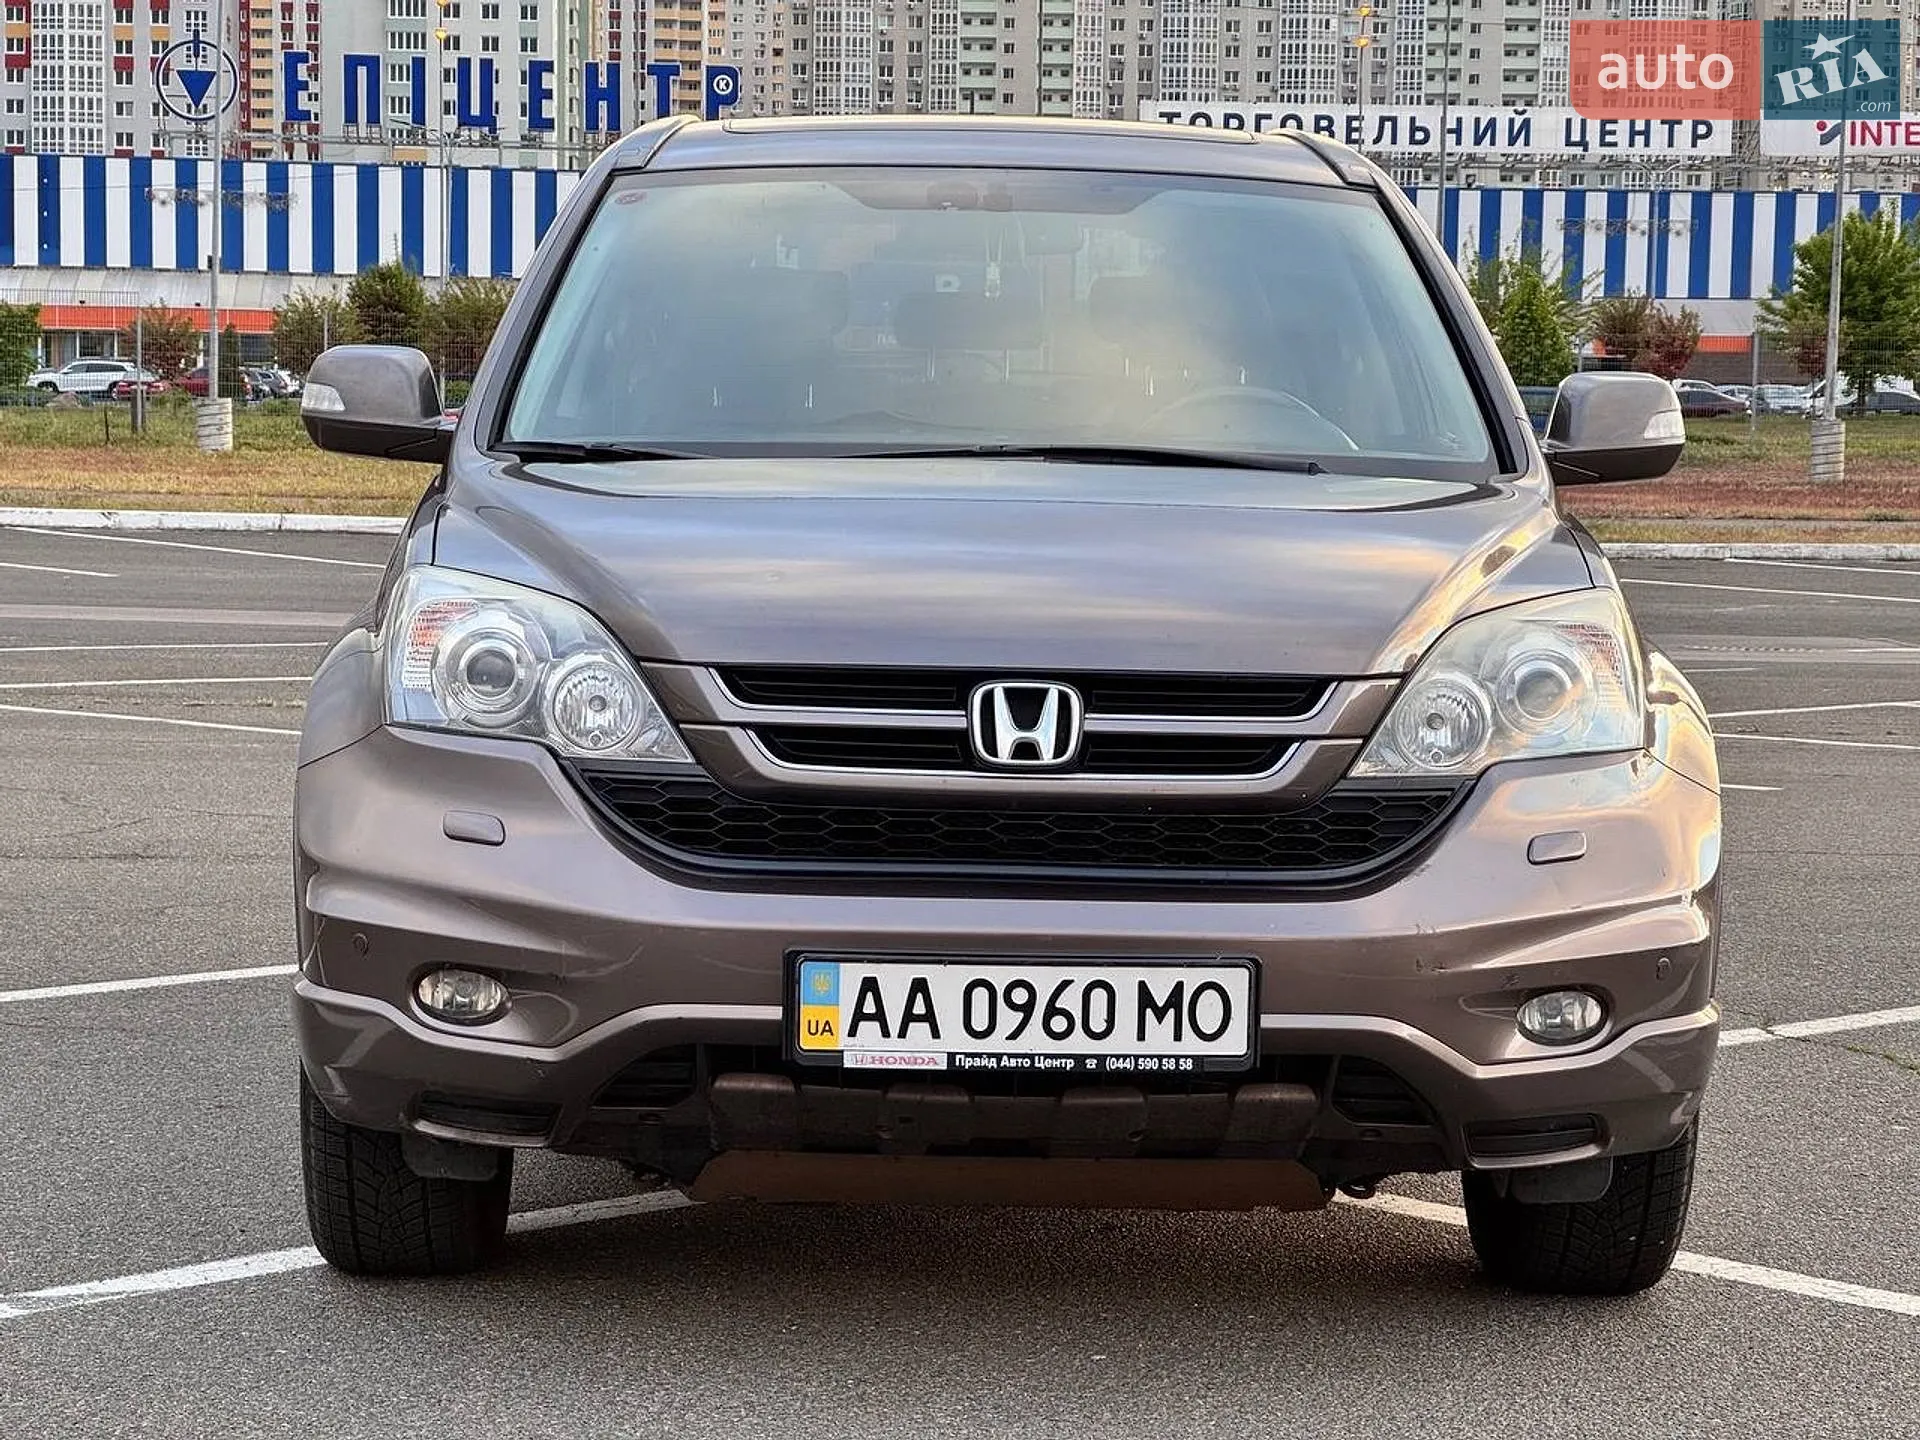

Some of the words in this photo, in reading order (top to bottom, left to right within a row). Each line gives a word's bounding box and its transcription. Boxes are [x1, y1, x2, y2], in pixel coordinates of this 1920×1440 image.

[283, 50, 741, 134] ЕПІЦЕНТР
[1564, 117, 1714, 152] ЦЕНТР
[847, 976, 942, 1039] AA
[962, 978, 1117, 1042] 0960
[1136, 979, 1233, 1043] MO
[807, 1019, 834, 1036] UA
[869, 1055, 938, 1066] HONDA
[955, 1054, 998, 1069] Прайд
[1000, 1055, 1031, 1068] Авто
[1034, 1056, 1075, 1070] Центр
[1105, 1056, 1135, 1071] (044)
[1137, 1057, 1159, 1070] 590
[1161, 1058, 1176, 1070] 58
[1178, 1058, 1193, 1071] 58
